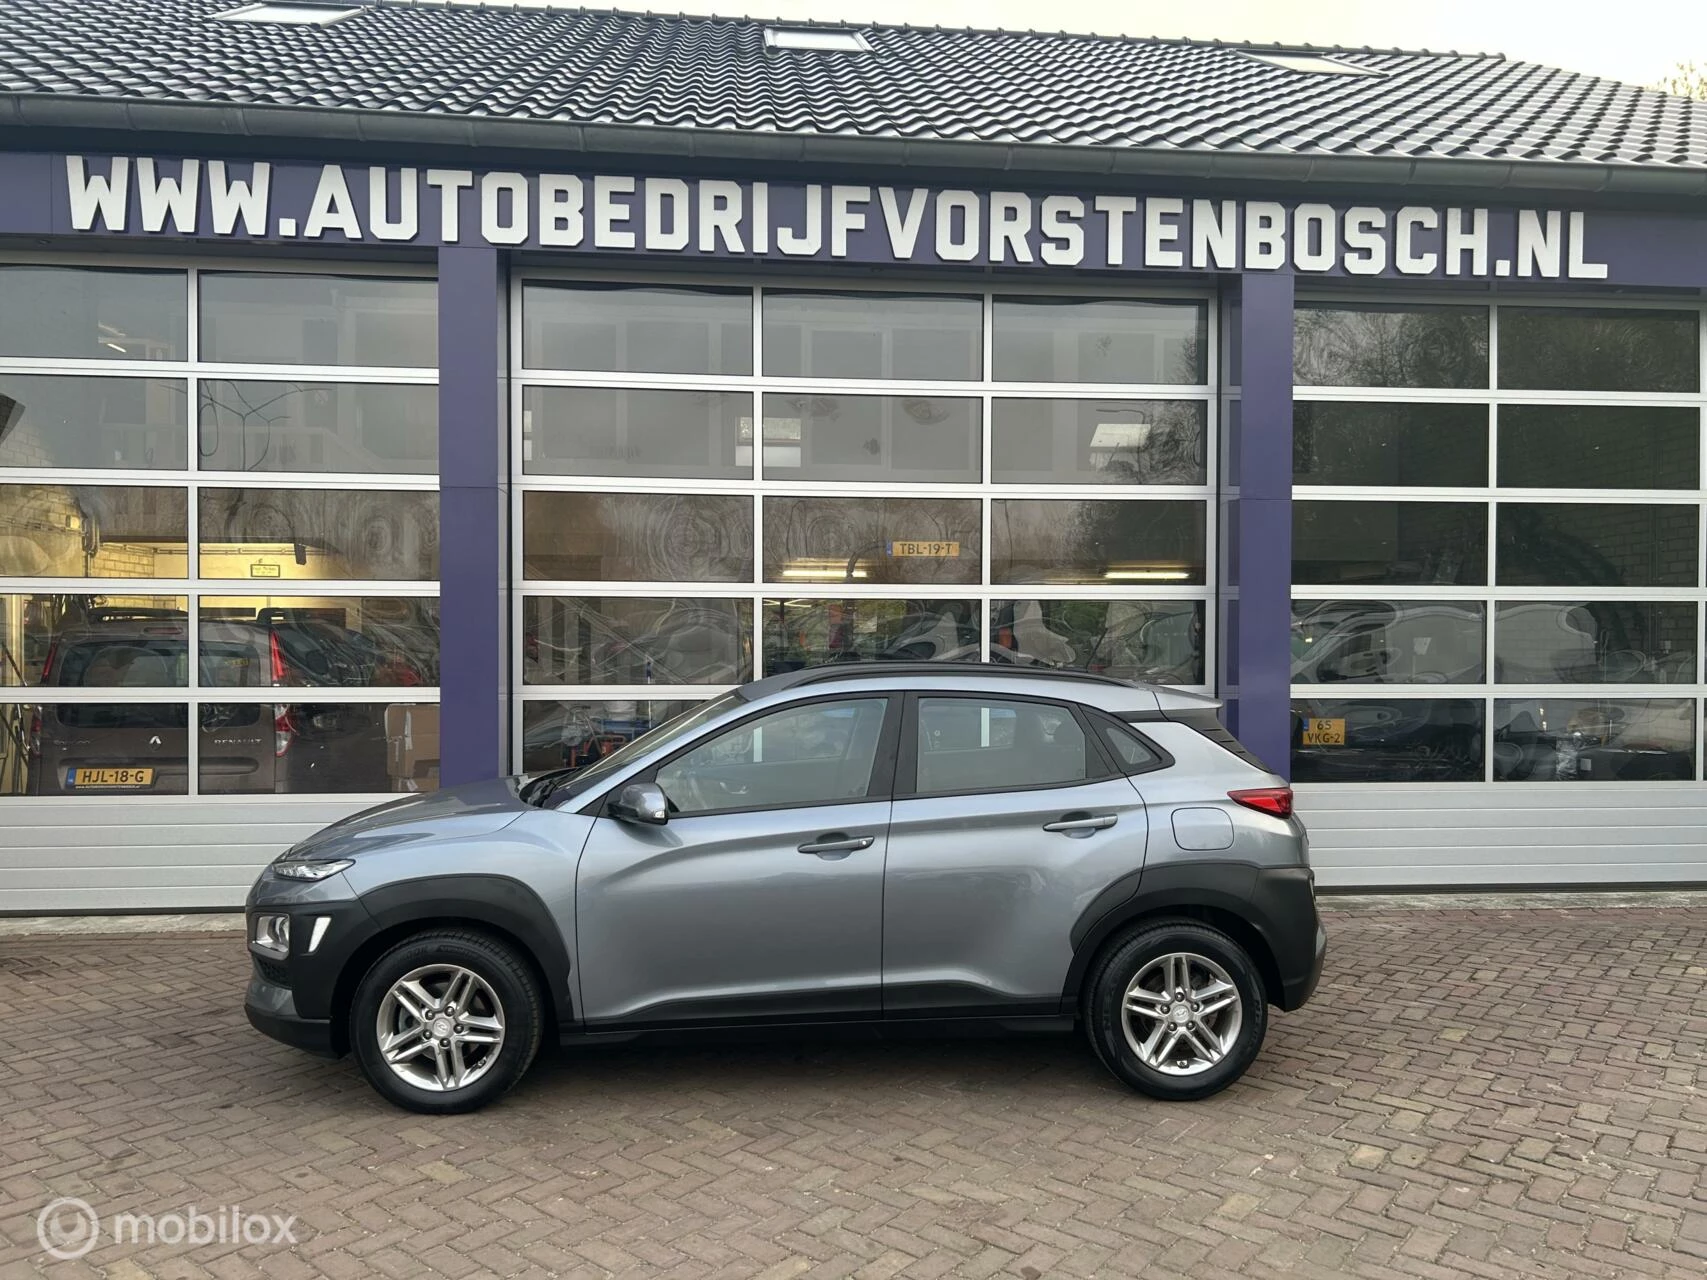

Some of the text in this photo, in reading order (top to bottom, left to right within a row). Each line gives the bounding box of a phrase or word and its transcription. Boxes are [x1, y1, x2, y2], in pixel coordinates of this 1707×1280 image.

[65, 155, 1608, 279] WWW.AUTOBEDRIJFVORSTENBOSCH.NL
[900, 543, 953, 555] TBL-19-T
[1317, 720, 1332, 730] 65
[1307, 732, 1341, 744] VKG-2
[82, 770, 145, 783] HJL-18-G
